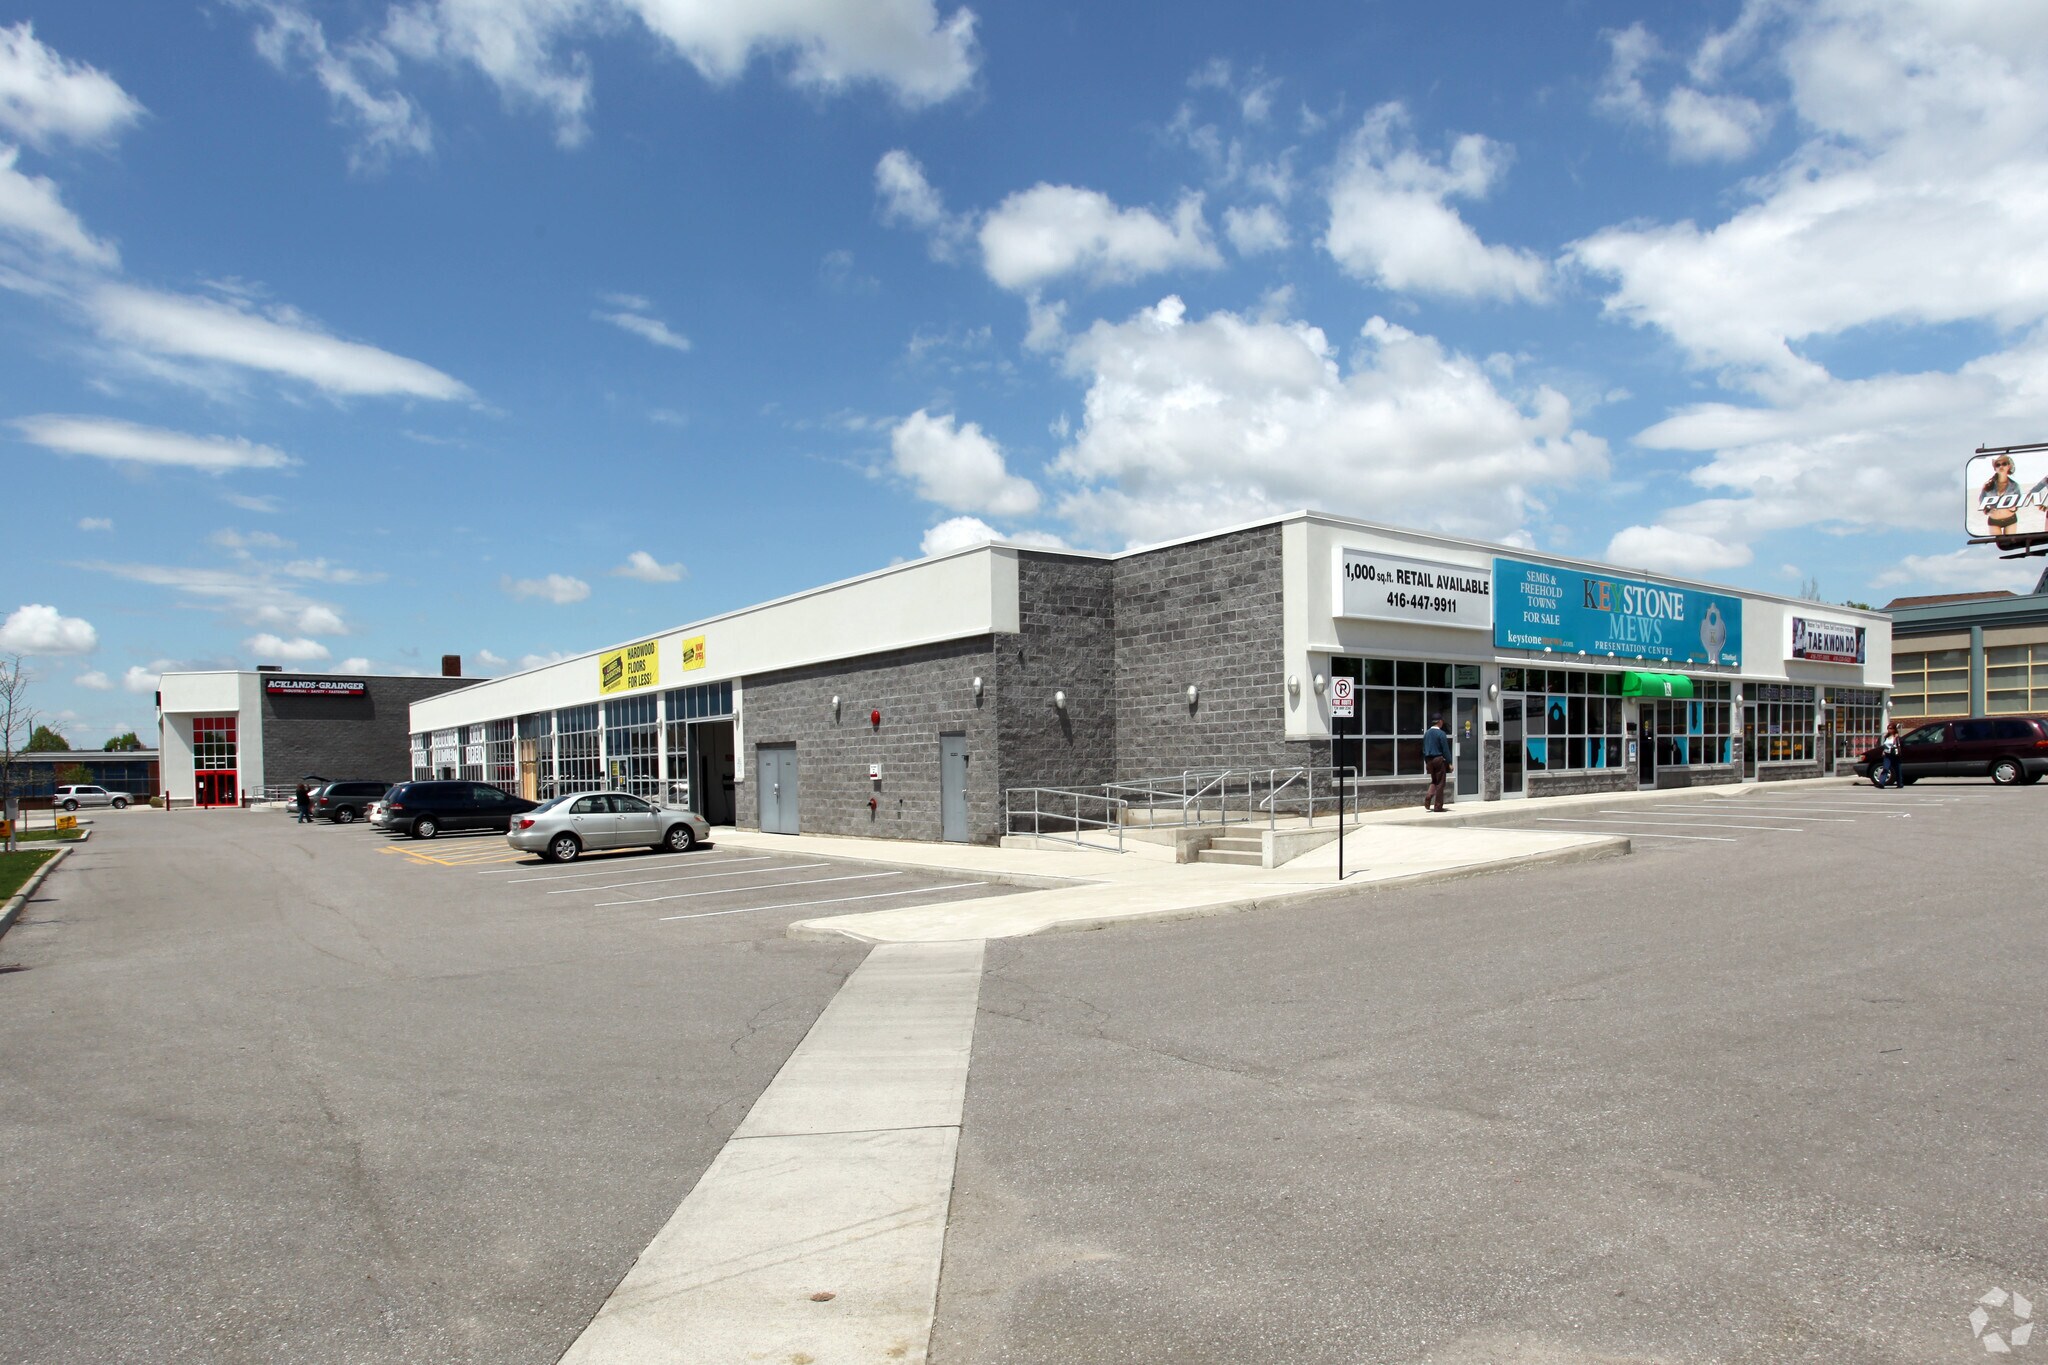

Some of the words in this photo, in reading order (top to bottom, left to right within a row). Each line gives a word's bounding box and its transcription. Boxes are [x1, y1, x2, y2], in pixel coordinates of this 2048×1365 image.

[1345, 562, 1375, 581] 1,000
[1377, 572, 1394, 585] sq.ft.
[1396, 569, 1434, 588] RETAIL
[1436, 575, 1489, 595] AVAILABLE
[1526, 570, 1550, 584] SEMIS
[1551, 575, 1557, 585] &
[1520, 582, 1563, 598] FREEHOLD
[1387, 591, 1457, 613] 416-447-9911
[1527, 596, 1556, 610] TOWNS
[1582, 579, 1685, 621] KEYSTONE
[1523, 611, 1540, 623] FOR
[1541, 613, 1560, 625] SALE
[1609, 613, 1663, 645] MEWS
[1594, 641, 1646, 653] PRESENTATION
[1648, 647, 1673, 656] CENTRE
[1808, 631, 1822, 650] TAE
[1824, 634, 1845, 652] KWON
[1846, 636, 1855, 653] DO
[627, 642, 654, 659] HARDWOOD
[628, 660, 646, 674] FLOORS
[267, 680, 364, 690] ACKLANDS-GRAINGER
[628, 675, 638, 688] FOR
[638, 672, 652, 687] LESS!
[1340, 683, 1347, 694] P
